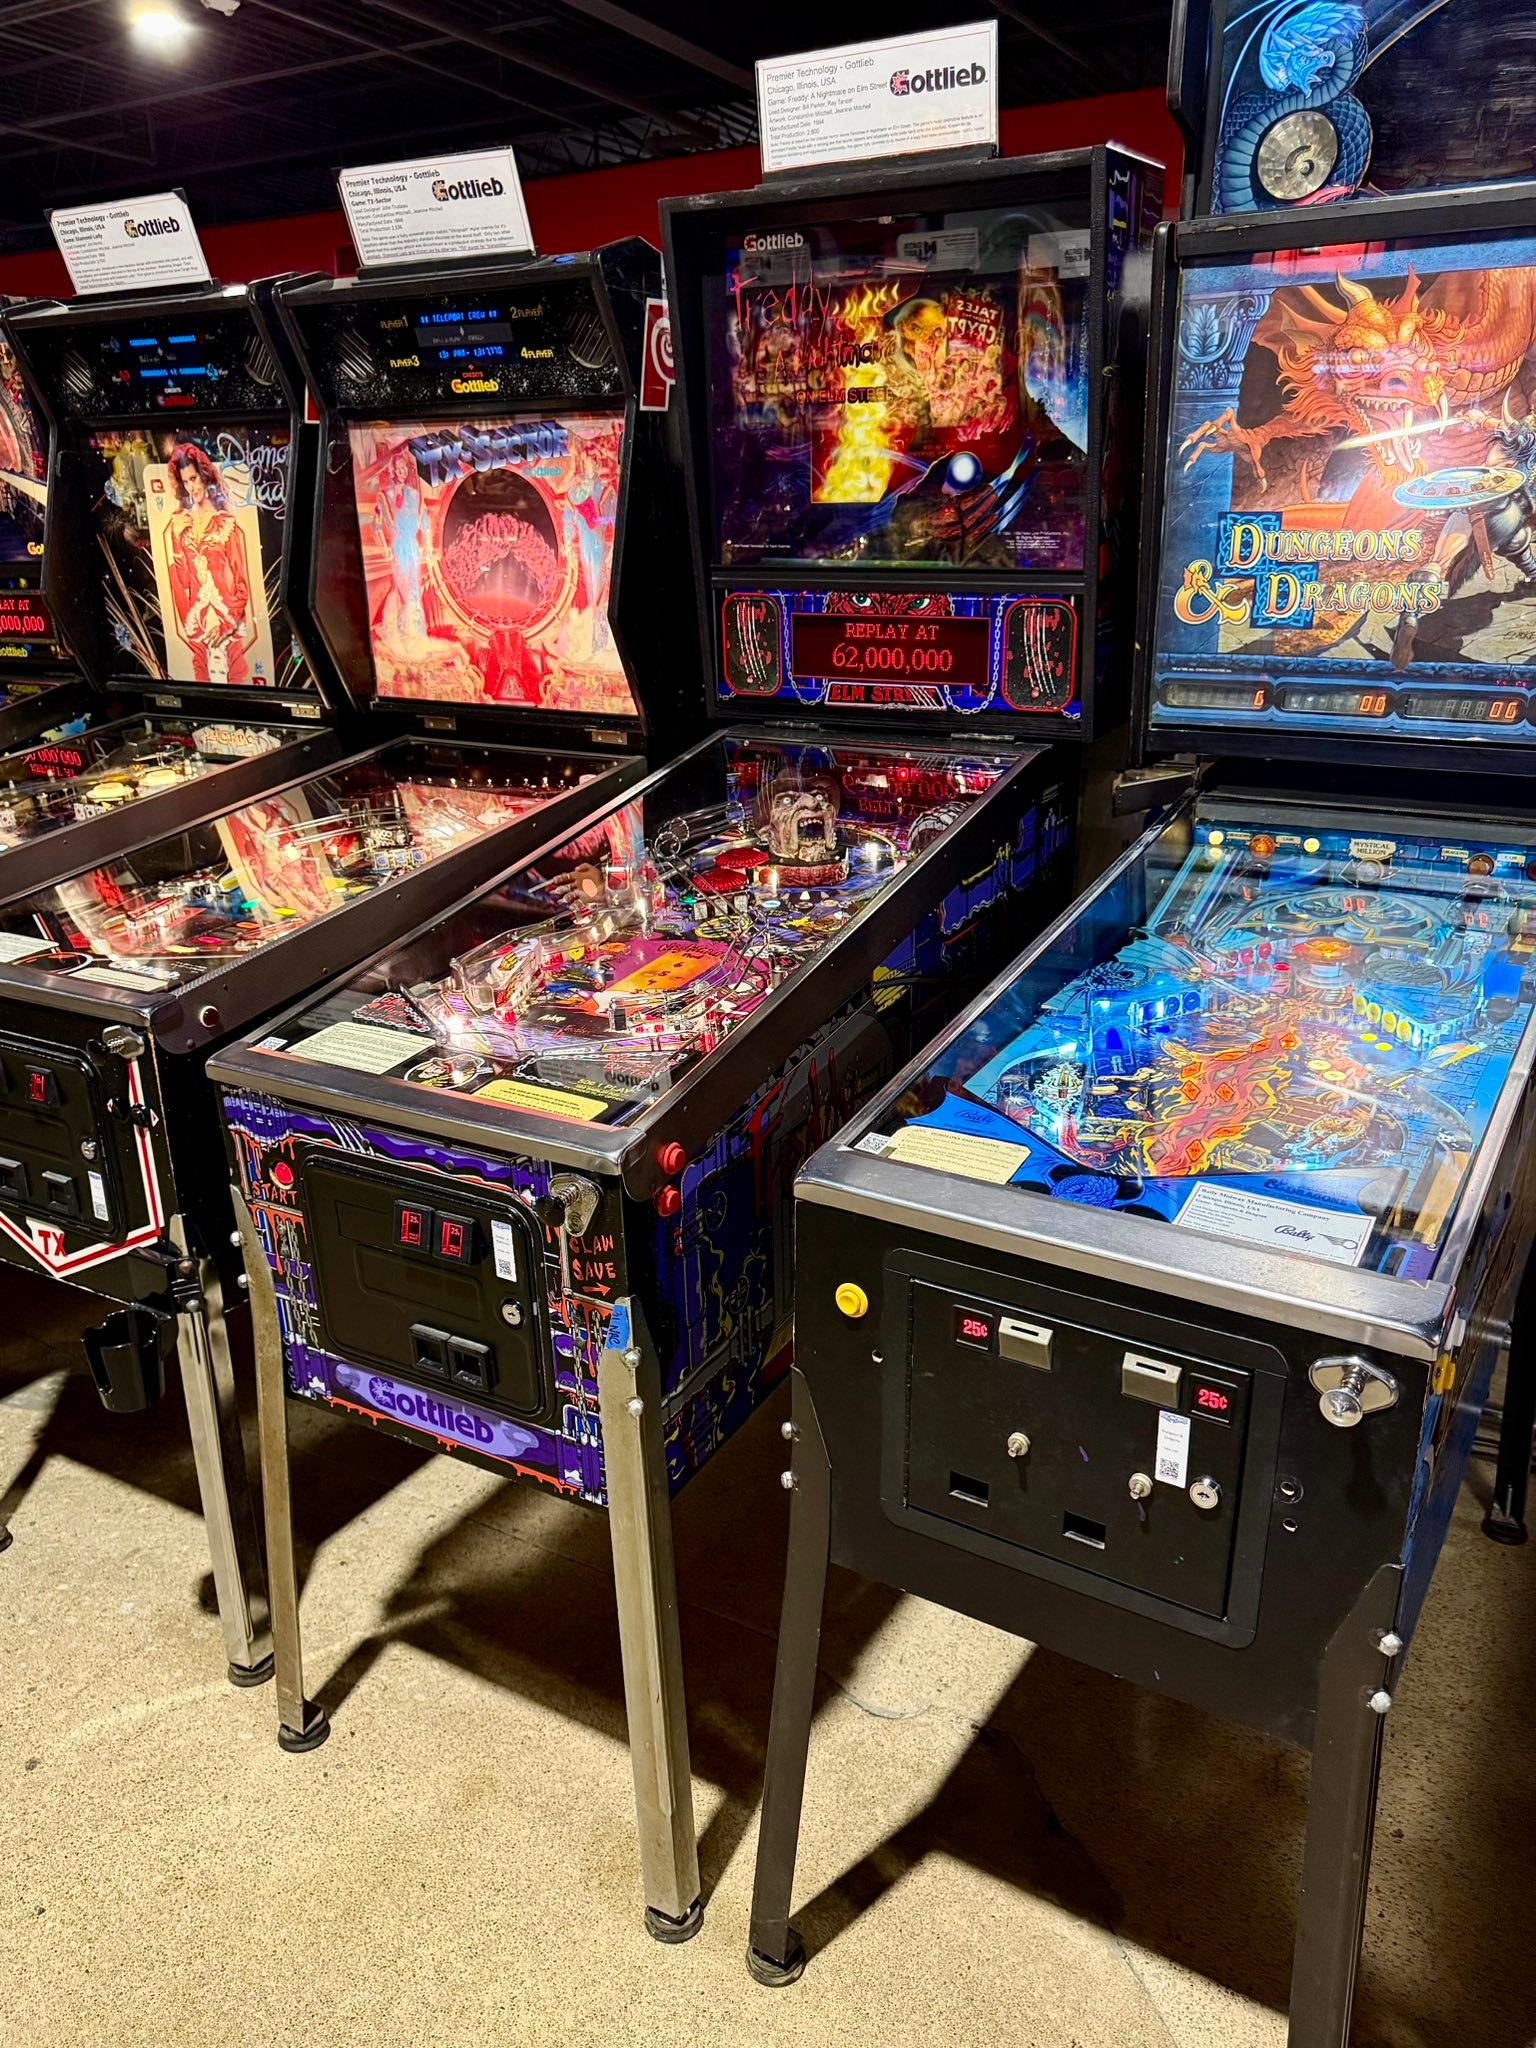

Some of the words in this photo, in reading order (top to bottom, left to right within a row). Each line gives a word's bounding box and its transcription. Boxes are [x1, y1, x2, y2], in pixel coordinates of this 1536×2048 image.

[767, 72, 795, 83] Premier
[797, 65, 838, 78] Technology
[845, 58, 874, 70] Gottlieb
[890, 62, 987, 97] Gottlieb
[767, 84, 795, 95] Chicago,
[797, 80, 819, 90] Illinois,
[821, 77, 836, 87] USA
[768, 97, 787, 106] Game:
[817, 88, 847, 99] Nightmare
[857, 84, 868, 92] Elm
[870, 81, 888, 91] Street
[346, 179, 369, 188] Premier
[371, 174, 408, 185] Technology
[413, 169, 440, 180] Gottlieb
[432, 177, 505, 201] Gottlieb
[349, 189, 373, 198] Chicago,
[76, 215, 105, 224] Technology
[109, 210, 129, 219] Gottlieb
[124, 216, 180, 238] Gottlieb
[744, 233, 804, 251] Gottlieb
[451, 378, 500, 394] Gottlieb
[1228, 522, 1423, 568] DUNGEONS
[1264, 571, 1442, 618] DRAGONS
[0, 615, 45, 633] ,000,000
[845, 623, 911, 640] REPLAY
[916, 624, 940, 641] AT
[832, 643, 953, 673] 62,000,000
[829, 684, 865, 702] ELM
[1353, 840, 1391, 850] MYSTICAL
[1356, 847, 1387, 857] MILLION
[954, 1109, 993, 1124] Bally
[252, 1180, 298, 1205] START
[1201, 1188, 1217, 1196] Bally
[1220, 1192, 1245, 1202] Midway
[1247, 1197, 1296, 1215] Manufacturing
[1298, 1210, 1330, 1221] Company
[38, 1230, 67, 1257] TX
[1274, 1225, 1316, 1242] Bally
[569, 1234, 614, 1255] CLAW
[572, 1258, 616, 1282] SAVE
[963, 1319, 988, 1337] 25¢
[1198, 1389, 1229, 1410] 25¢
[369, 1377, 494, 1444] Gottlieb
